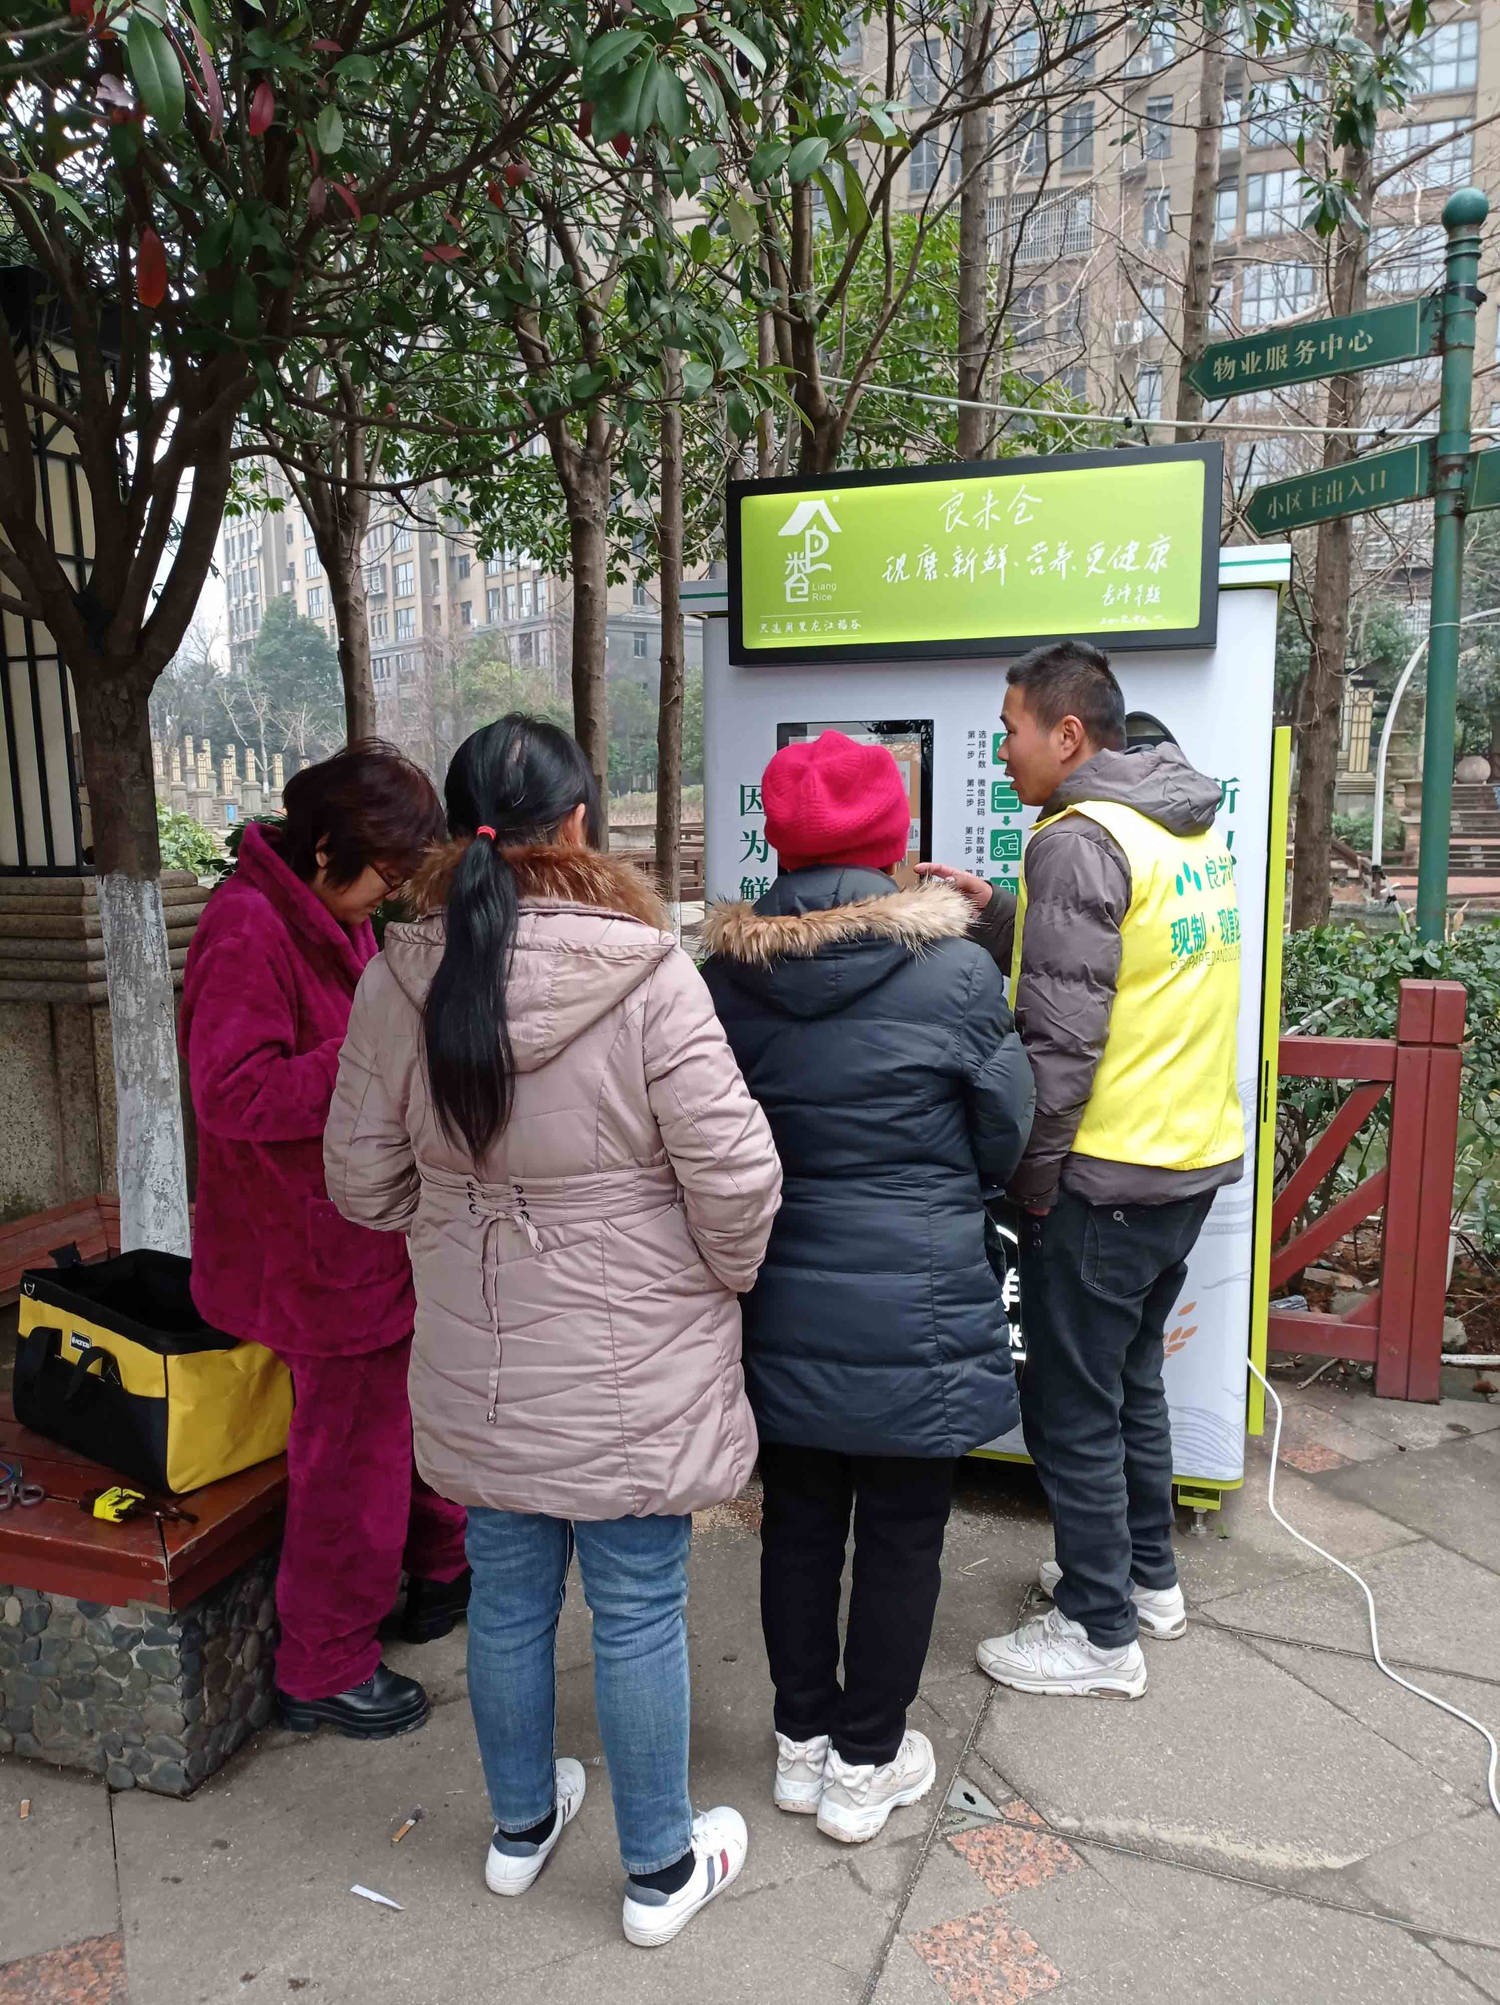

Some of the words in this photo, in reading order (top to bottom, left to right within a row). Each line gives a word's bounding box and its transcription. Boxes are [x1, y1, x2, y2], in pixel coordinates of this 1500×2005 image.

[1213, 329, 1374, 383] 物业服务中心
[939, 484, 1042, 533] 良米仓
[811, 583, 837, 592] Liang
[811, 592, 832, 601] Rice
[967, 730, 976, 759] 第一步
[978, 730, 987, 768] 选择斤数
[966, 779, 975, 807] 第二步
[977, 779, 986, 816] 微信扫码
[965, 826, 974, 855] 第三步
